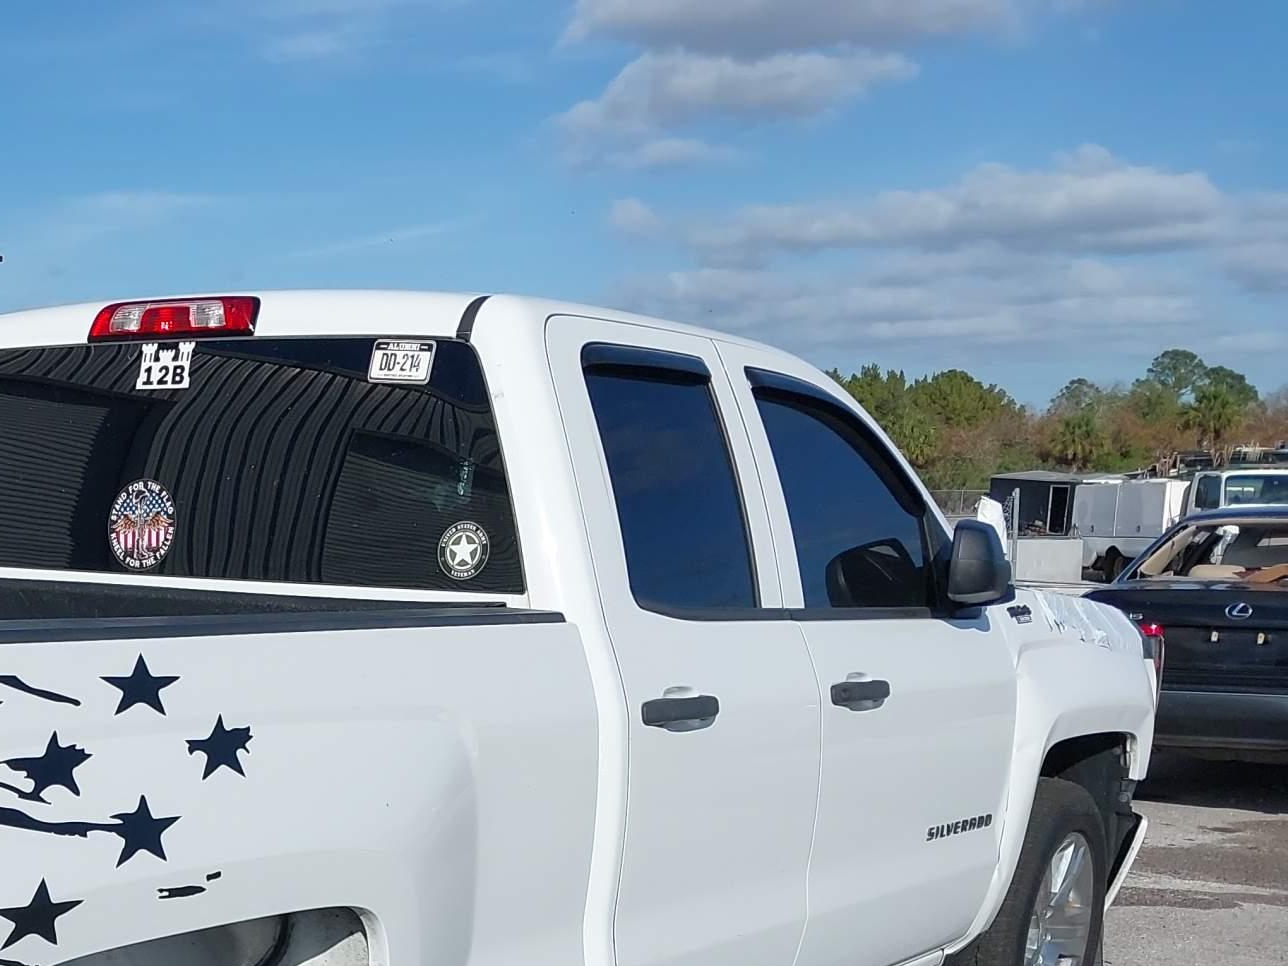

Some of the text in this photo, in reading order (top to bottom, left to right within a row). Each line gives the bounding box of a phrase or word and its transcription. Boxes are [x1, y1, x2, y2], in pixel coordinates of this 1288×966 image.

[387, 342, 421, 351] ALUMNI
[379, 352, 422, 372] DD-214
[142, 365, 185, 385] 12B
[111, 481, 174, 521] STAND FOR THE FLAG
[110, 526, 174, 568] KNEEL FOR THE FALLEN
[926, 814, 993, 841] SILVERADO
